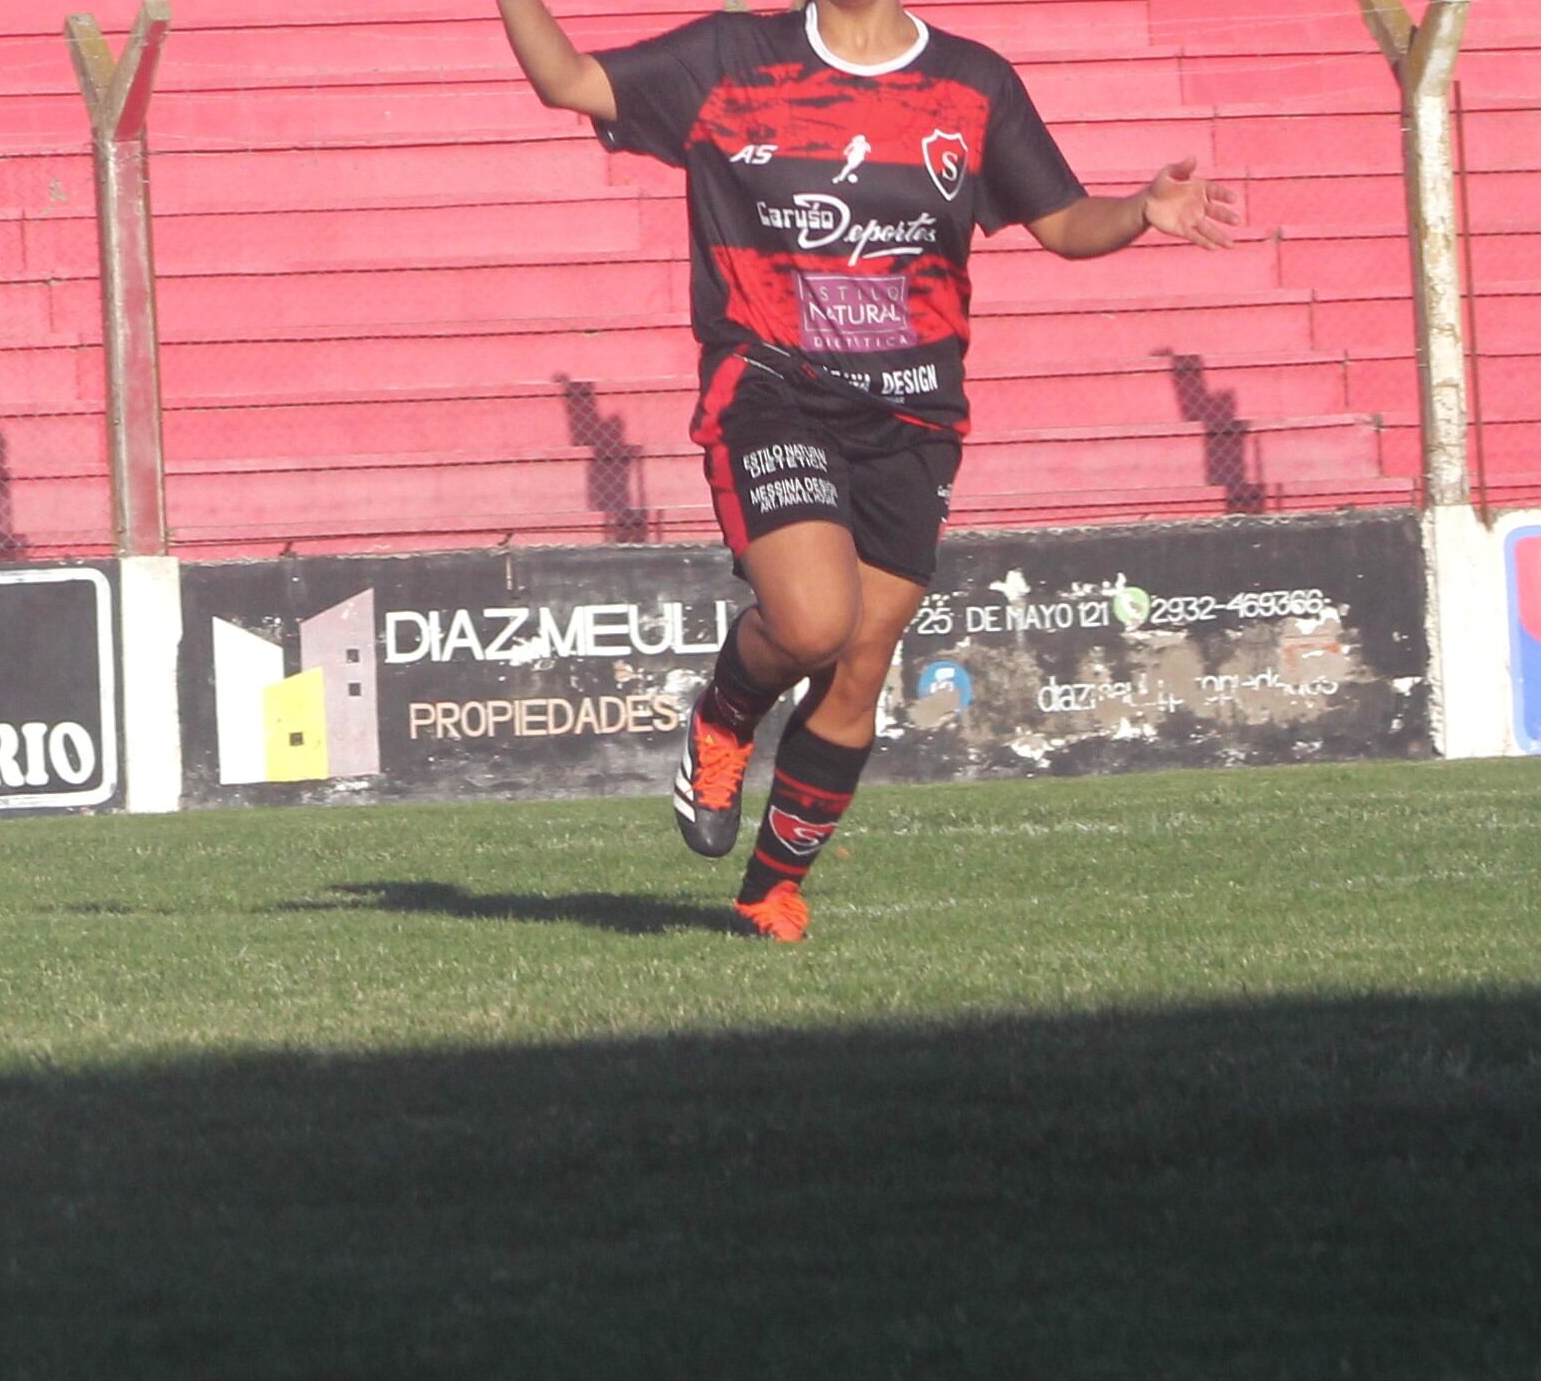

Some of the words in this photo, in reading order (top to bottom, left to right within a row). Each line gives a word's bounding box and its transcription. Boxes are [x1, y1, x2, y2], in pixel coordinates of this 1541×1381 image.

[730, 144, 778, 165] AS
[881, 363, 939, 396] DESIGN
[918, 607, 953, 635] 25
[966, 606, 1003, 633] DE
[1006, 603, 1072, 631] MAYO
[1077, 601, 1109, 627] 121
[408, 695, 682, 739] PROPIEDADES
